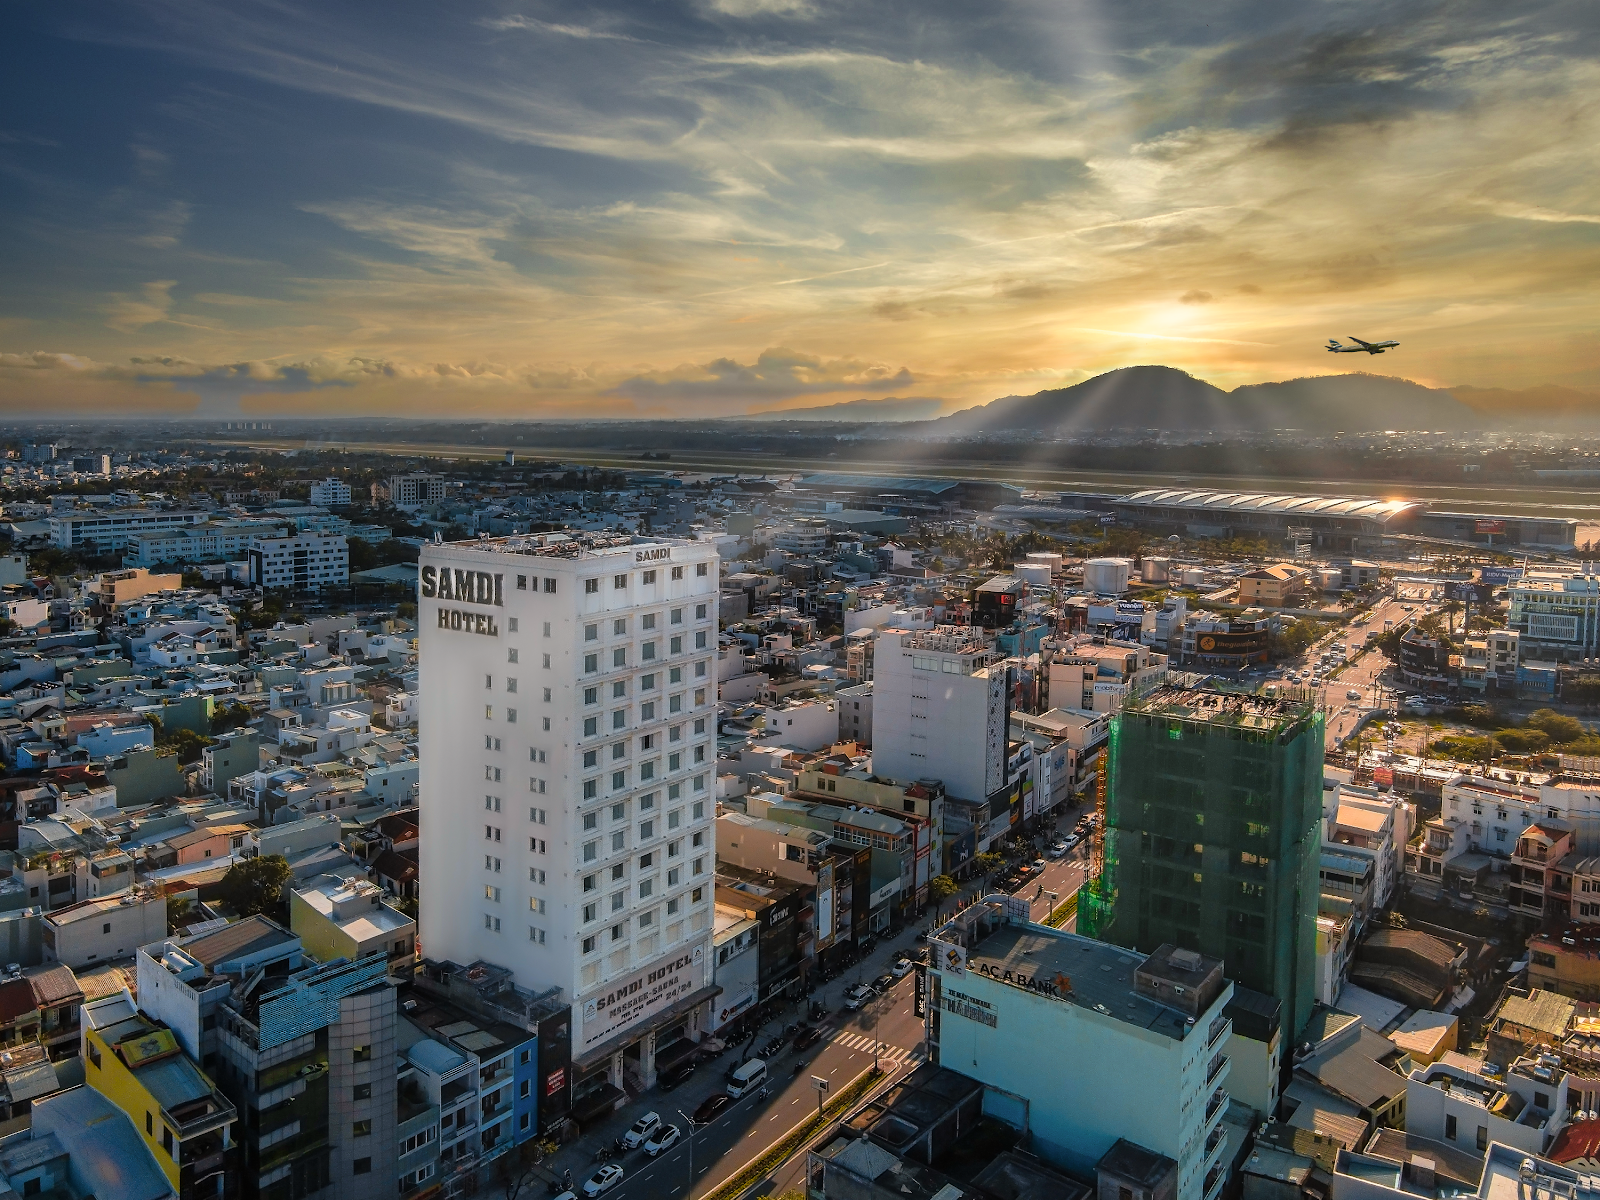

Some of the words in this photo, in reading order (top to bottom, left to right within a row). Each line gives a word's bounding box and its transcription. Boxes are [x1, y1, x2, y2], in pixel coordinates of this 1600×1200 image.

[635, 547, 671, 563] SAMDI
[421, 564, 504, 607] SAMDI
[437, 607, 499, 637] HOTEL
[945, 963, 962, 975] SCIC
[597, 978, 643, 1011] SAMDI
[647, 955, 692, 985] HOTEL
[666, 980, 692, 1000] 24/24
[1018, 973, 1059, 997] BANK
